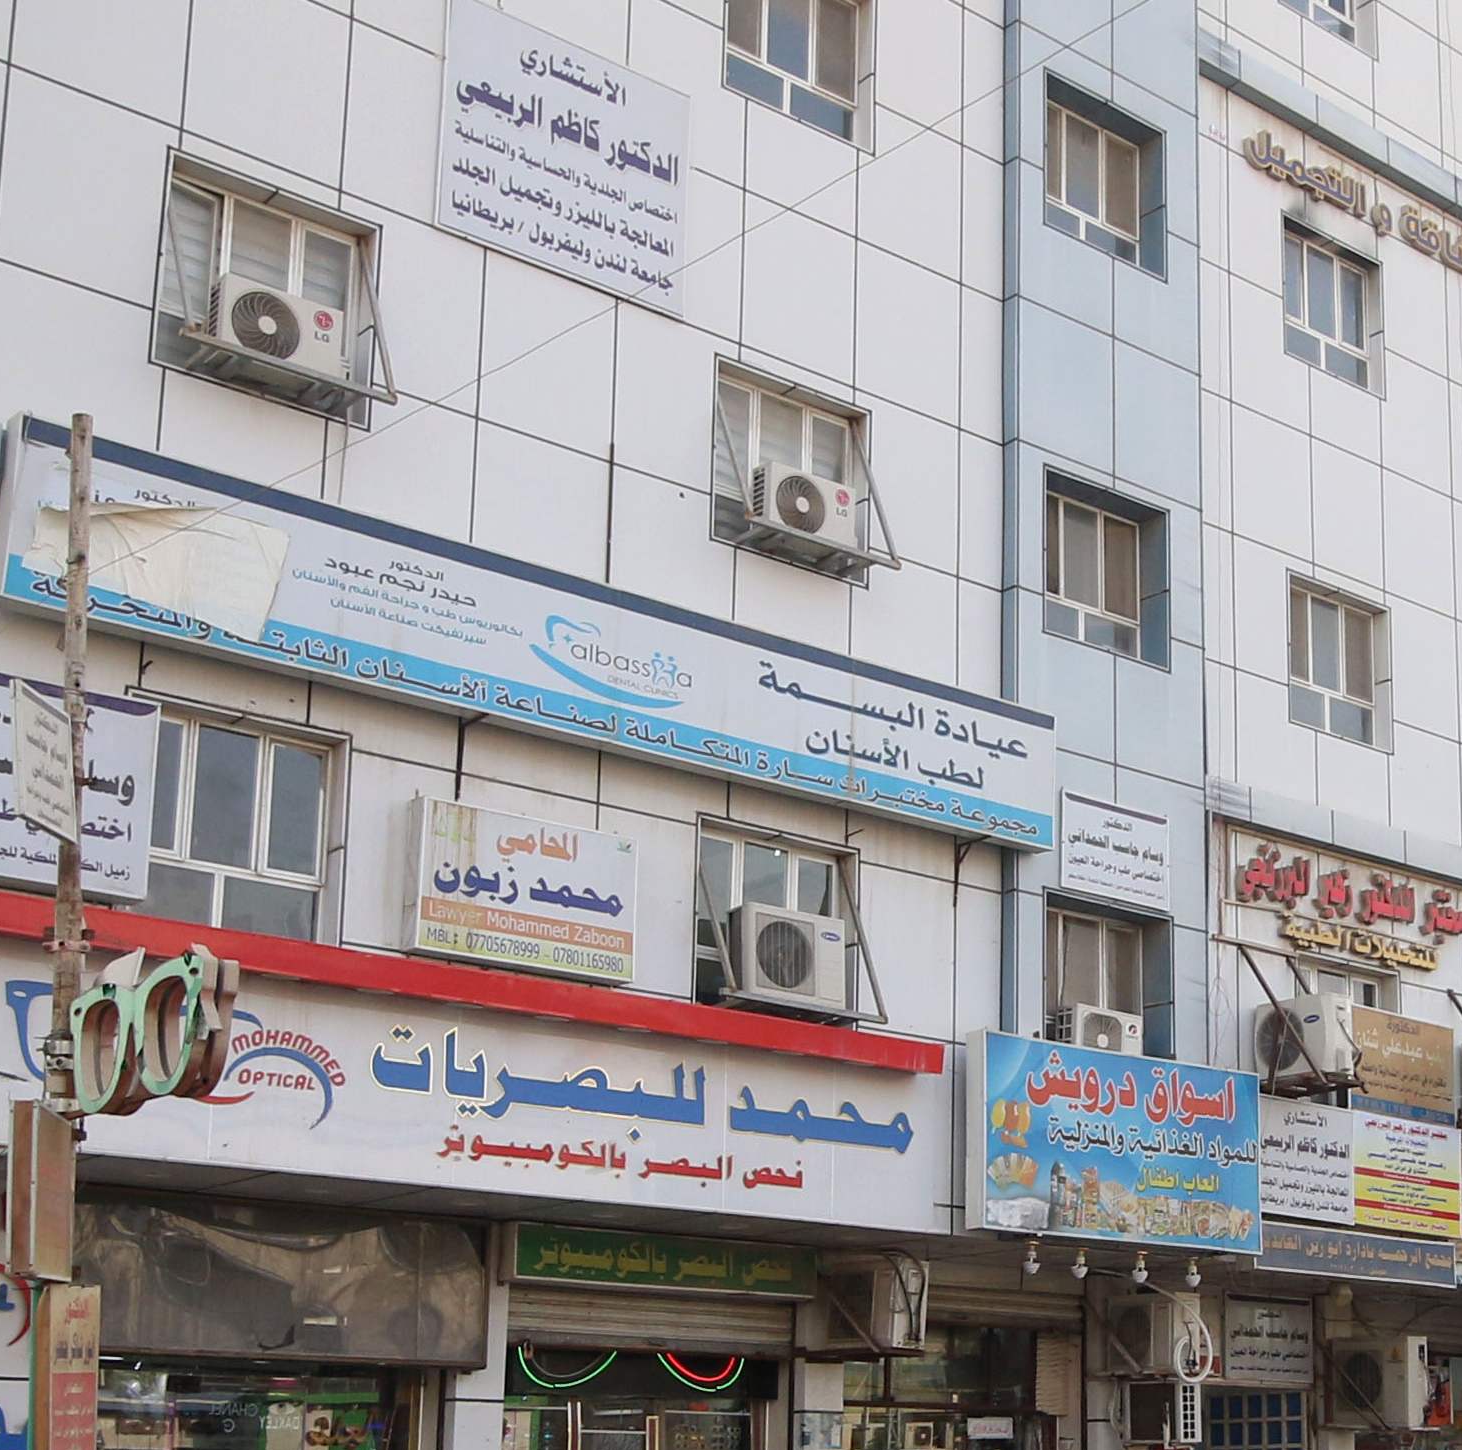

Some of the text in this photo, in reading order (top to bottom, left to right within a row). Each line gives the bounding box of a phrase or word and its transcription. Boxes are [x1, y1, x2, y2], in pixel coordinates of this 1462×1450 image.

[520, 49, 626, 106] الأستشاري
[456, 80, 679, 186] الدكتور كاظم الربيعي
[455, 120, 678, 225] اختصاص الجلدية والحساسية والتناسلية
[452, 158, 674, 258] المعالجة بالليزر وتجميل الجلد
[452, 190, 515, 235] بريطانيا
[528, 222, 591, 264] وليفربول
[594, 244, 627, 274] لندن
[631, 258, 674, 296] جامعة
[314, 330, 330, 343] LG
[324, 558, 477, 607] حيدر نجم عبود
[389, 559, 444, 581] الدكتور
[757, 660, 1029, 760] عيادة البسمة
[495, 683, 1039, 837] مجموعة مختبرات سارة المتكاملة لصناعة
[806, 728, 984, 791] لطب الأسنان
[104, 862, 131, 881] زميل
[496, 827, 579, 863] المحامي
[434, 861, 624, 918] محمد زبون
[429, 902, 625, 949] Lawyer Mohammed Zaboon
[466, 932, 540, 961] 07705678999
[552, 947, 624, 973] 07801165980
[231, 1029, 346, 1088] MOHAMMED
[237, 1066, 317, 1092] OPTICAL
[370, 1023, 914, 1156] محمد للبصريات
[1025, 1049, 1236, 1127] اسواق درويش
[436, 1124, 804, 1191] فحص البصر بالكومبيوتر
[1048, 1115, 1258, 1168] للمواد الغذائية والمنزلية
